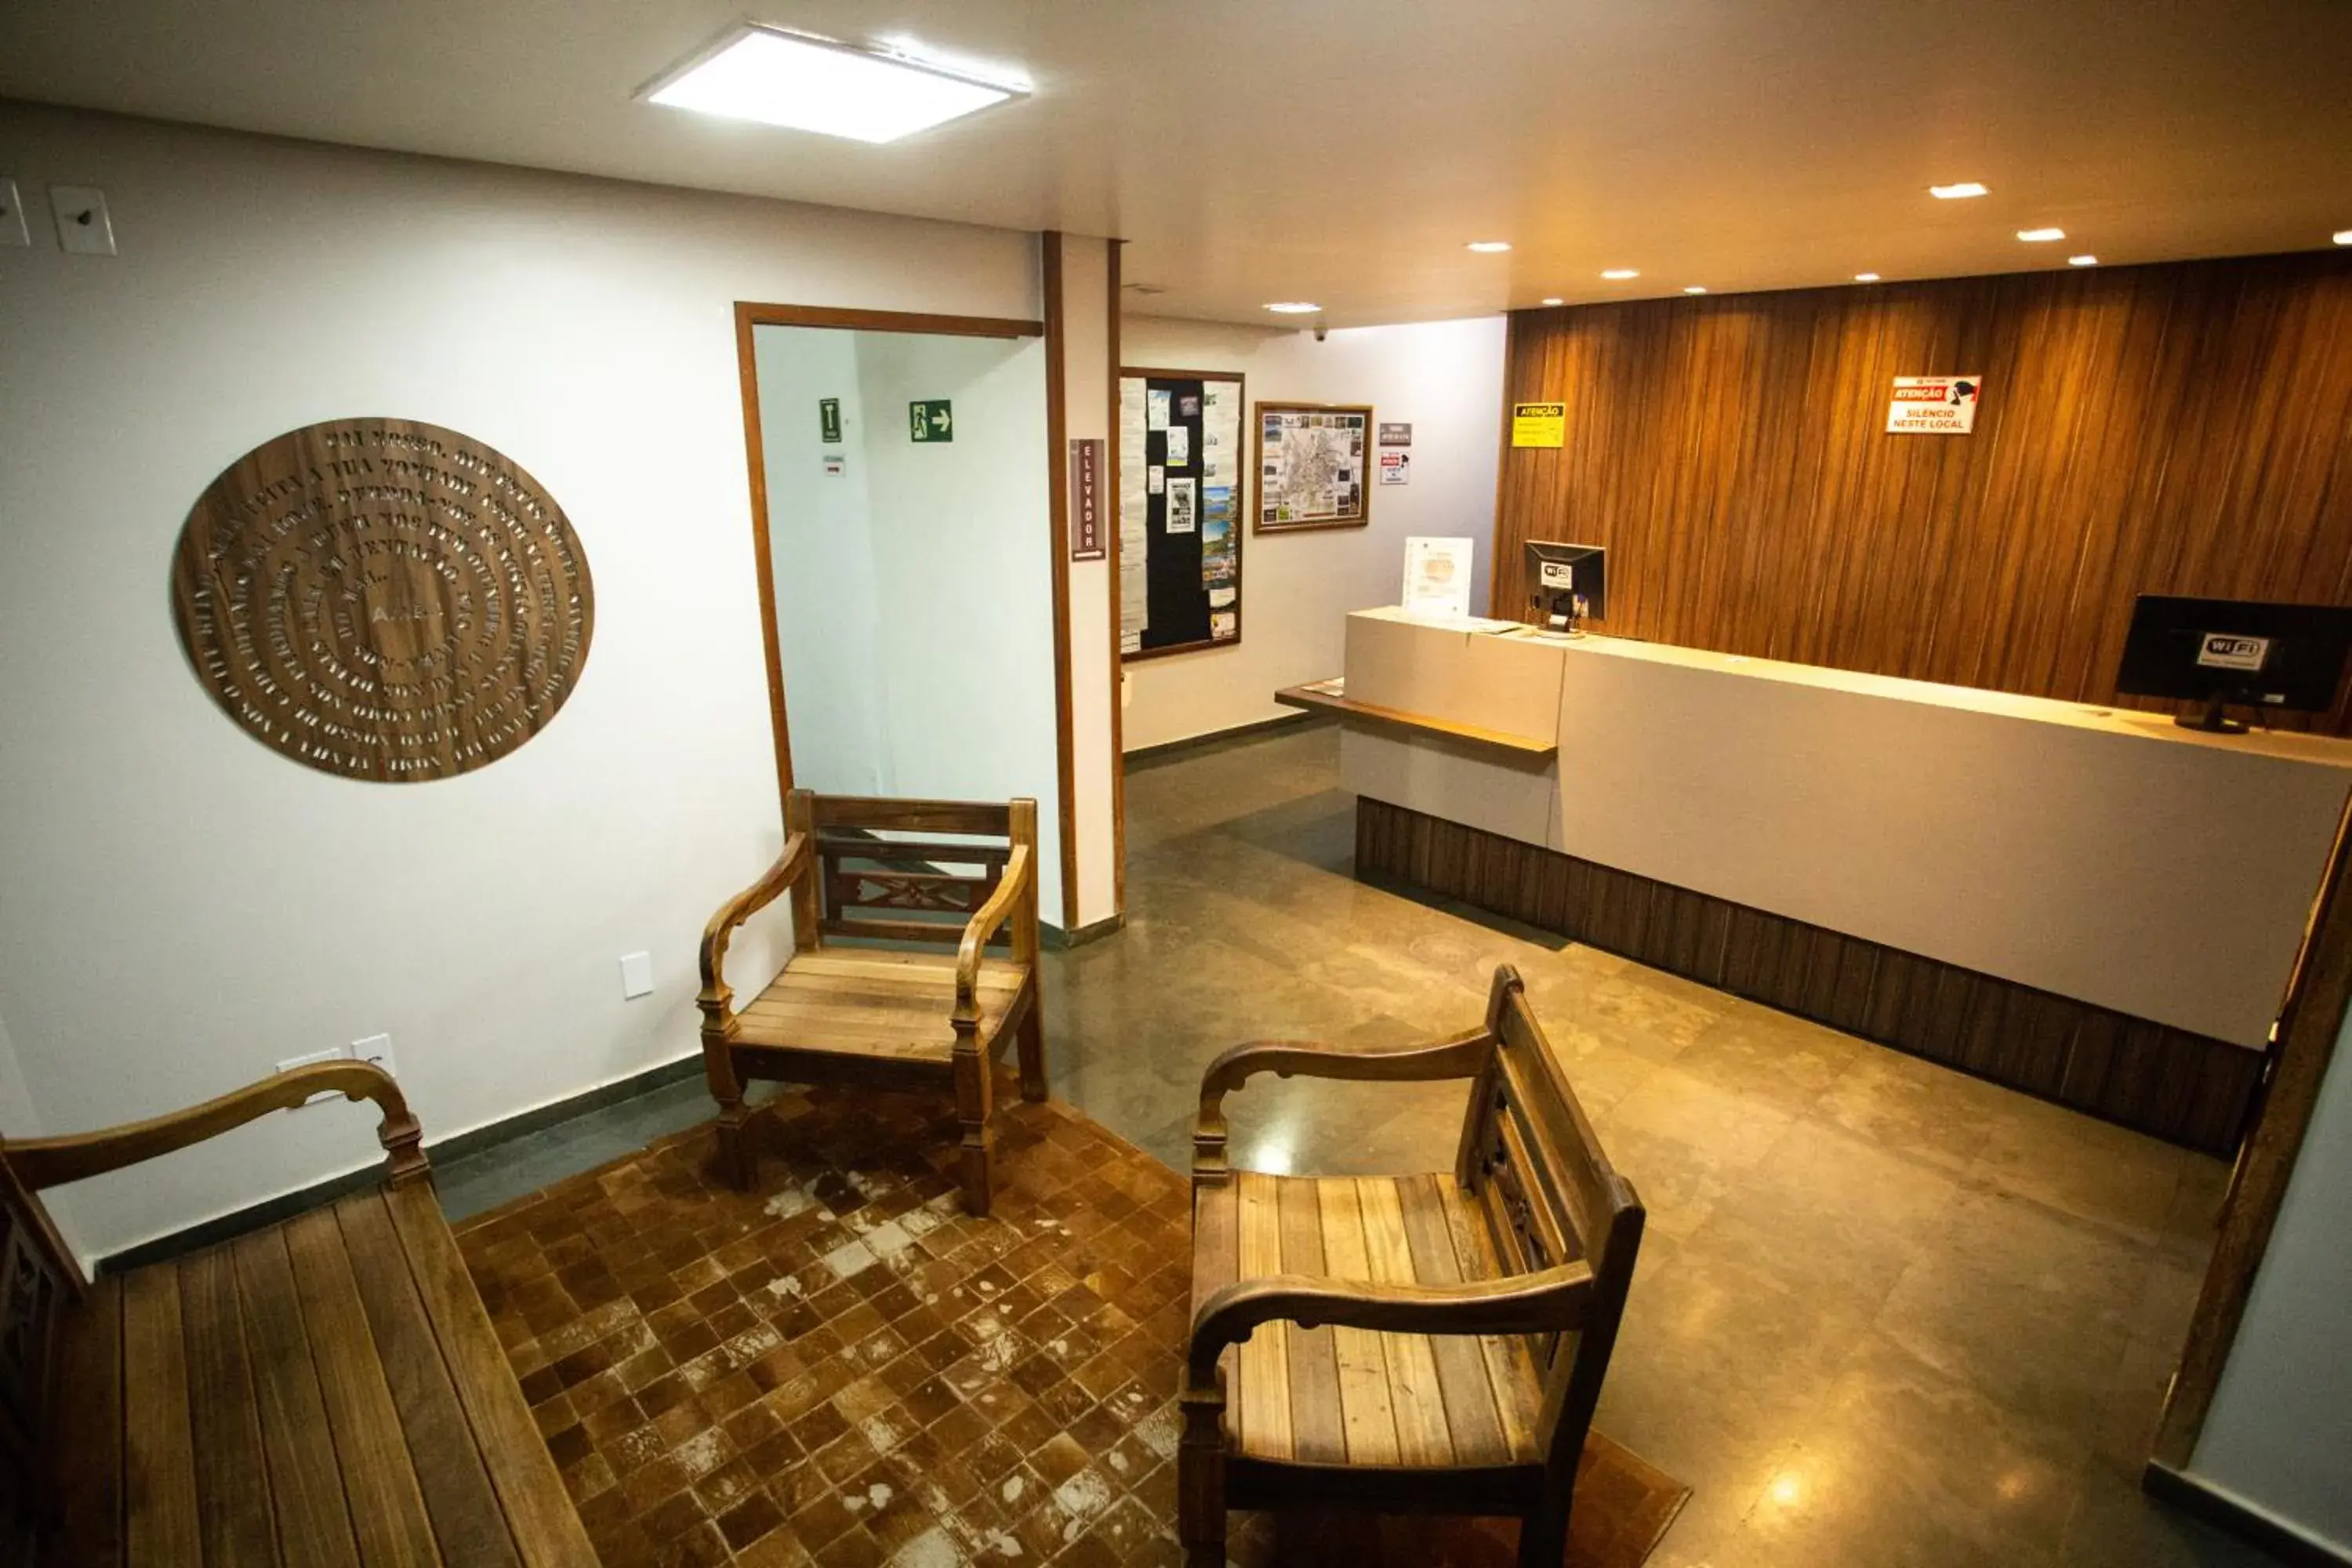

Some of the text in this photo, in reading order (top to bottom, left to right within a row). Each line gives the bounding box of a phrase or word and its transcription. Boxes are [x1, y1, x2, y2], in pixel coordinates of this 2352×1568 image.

[1893, 419, 1964, 429] NESTE LOCAL
[1084, 445, 1093, 546] ELEVADOR
